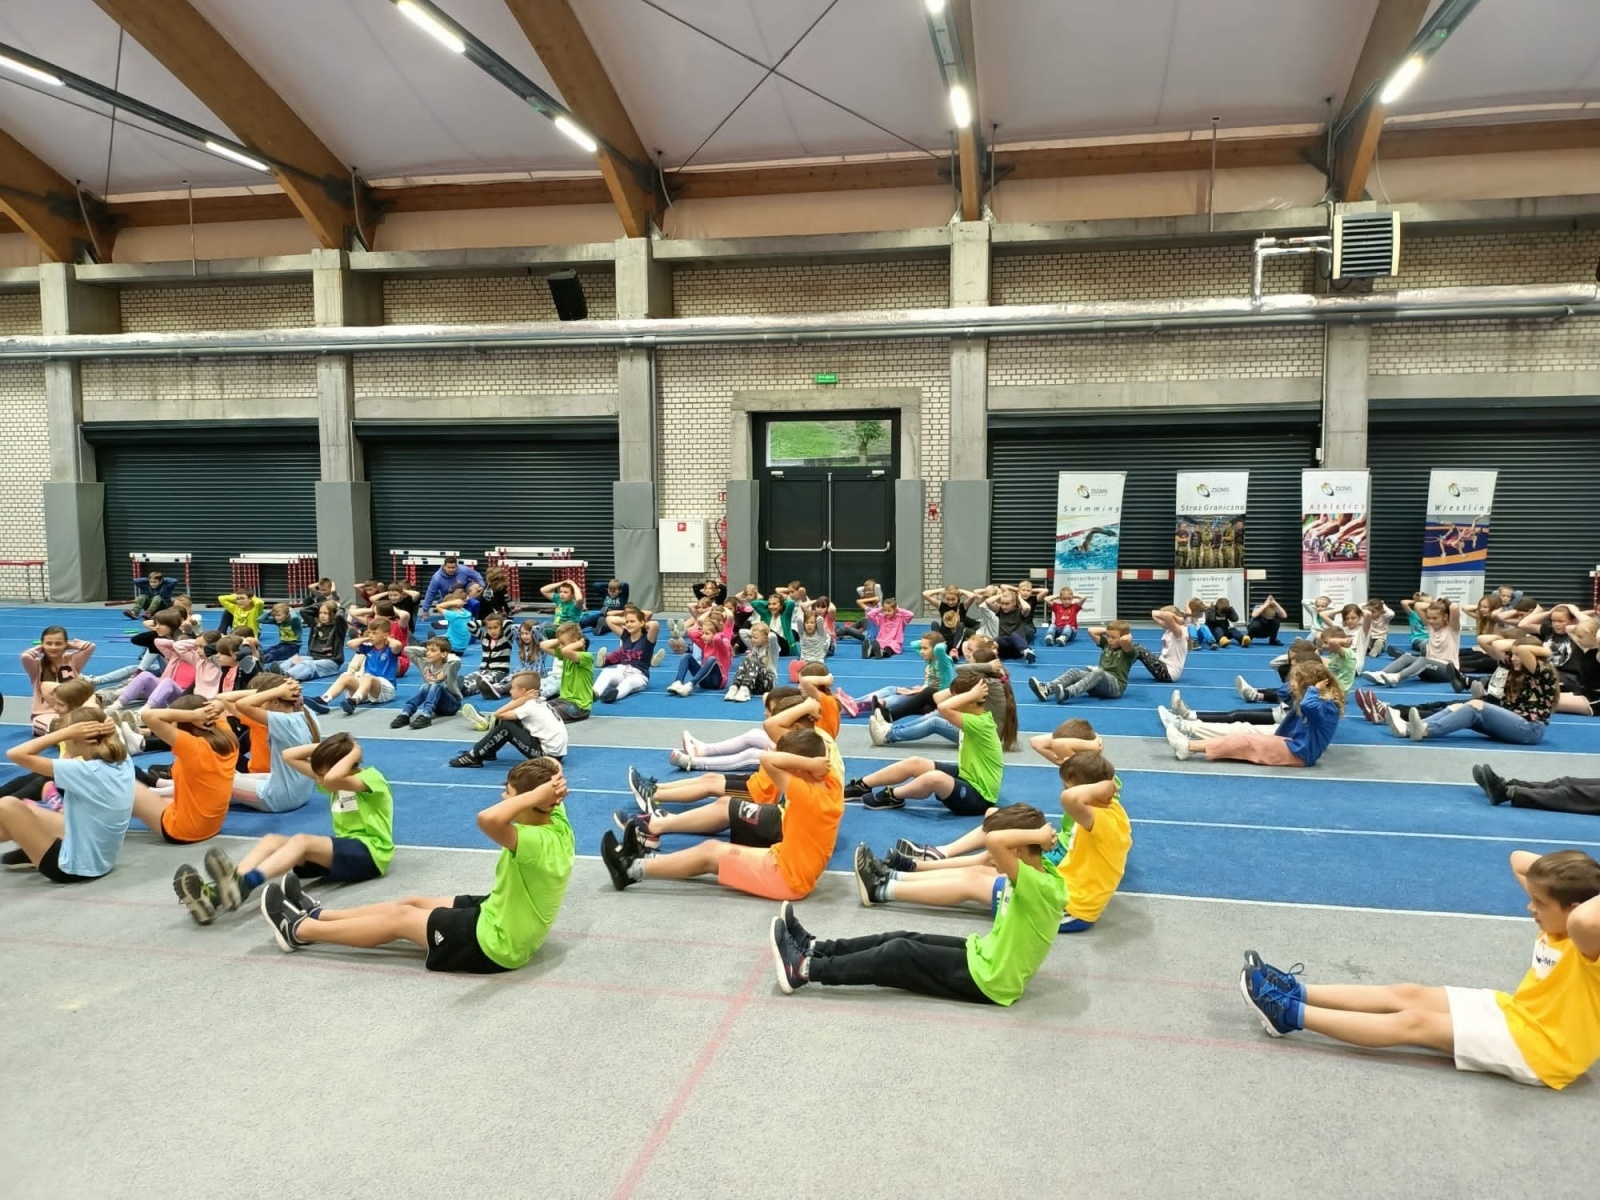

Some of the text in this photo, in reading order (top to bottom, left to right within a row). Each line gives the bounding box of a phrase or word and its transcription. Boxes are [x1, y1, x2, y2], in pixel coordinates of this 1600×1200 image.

[1063, 505, 1120, 514] Swimming
[1203, 503, 1245, 511] Graniczna
[1309, 503, 1366, 511] Athletics
[1434, 503, 1493, 514] Wrestling
